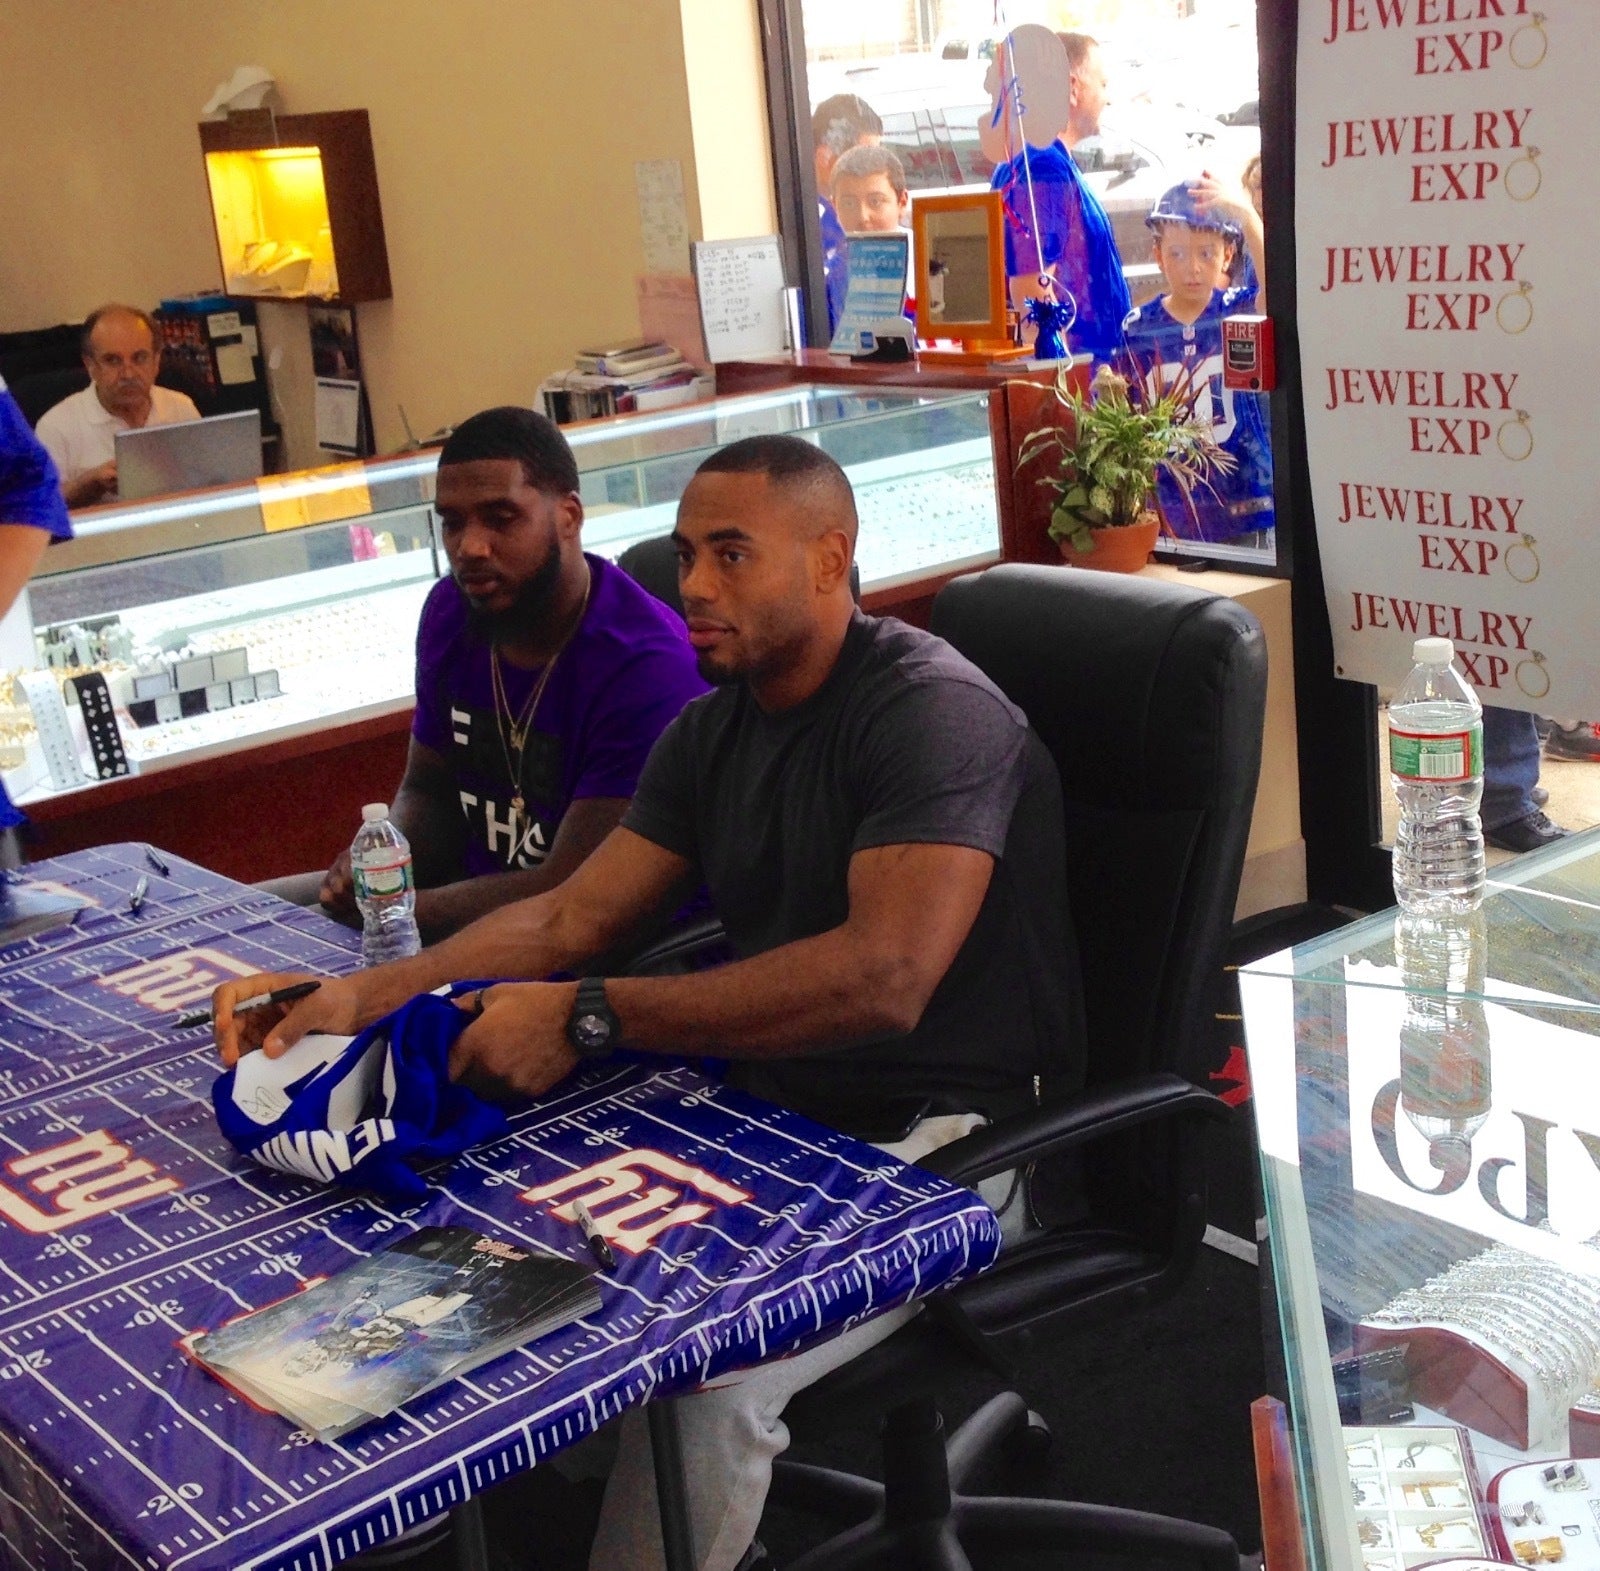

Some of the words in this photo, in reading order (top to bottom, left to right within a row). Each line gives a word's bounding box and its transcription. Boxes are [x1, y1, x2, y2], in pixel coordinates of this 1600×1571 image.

[1321, 108, 1533, 168] JEWELRY
[1320, 243, 1526, 292] JEWELRY
[1226, 321, 1256, 338] FIRE
[1325, 368, 1519, 411] JEWELRY
[1338, 482, 1524, 535] JEWELRY
[1351, 592, 1533, 650] JEWELRY
[1455, 650, 1509, 689] XP
[680, 1086, 719, 1107] 20
[583, 1126, 625, 1146] 30
[482, 1167, 522, 1187] 40
[169, 1193, 211, 1215] 40
[44, 1234, 92, 1258] 30
[259, 1251, 302, 1276] 40
[659, 1250, 698, 1274] 40
[133, 1299, 185, 1327] 30
[0, 1348, 52, 1381] 20
[147, 1482, 205, 1516] 20
